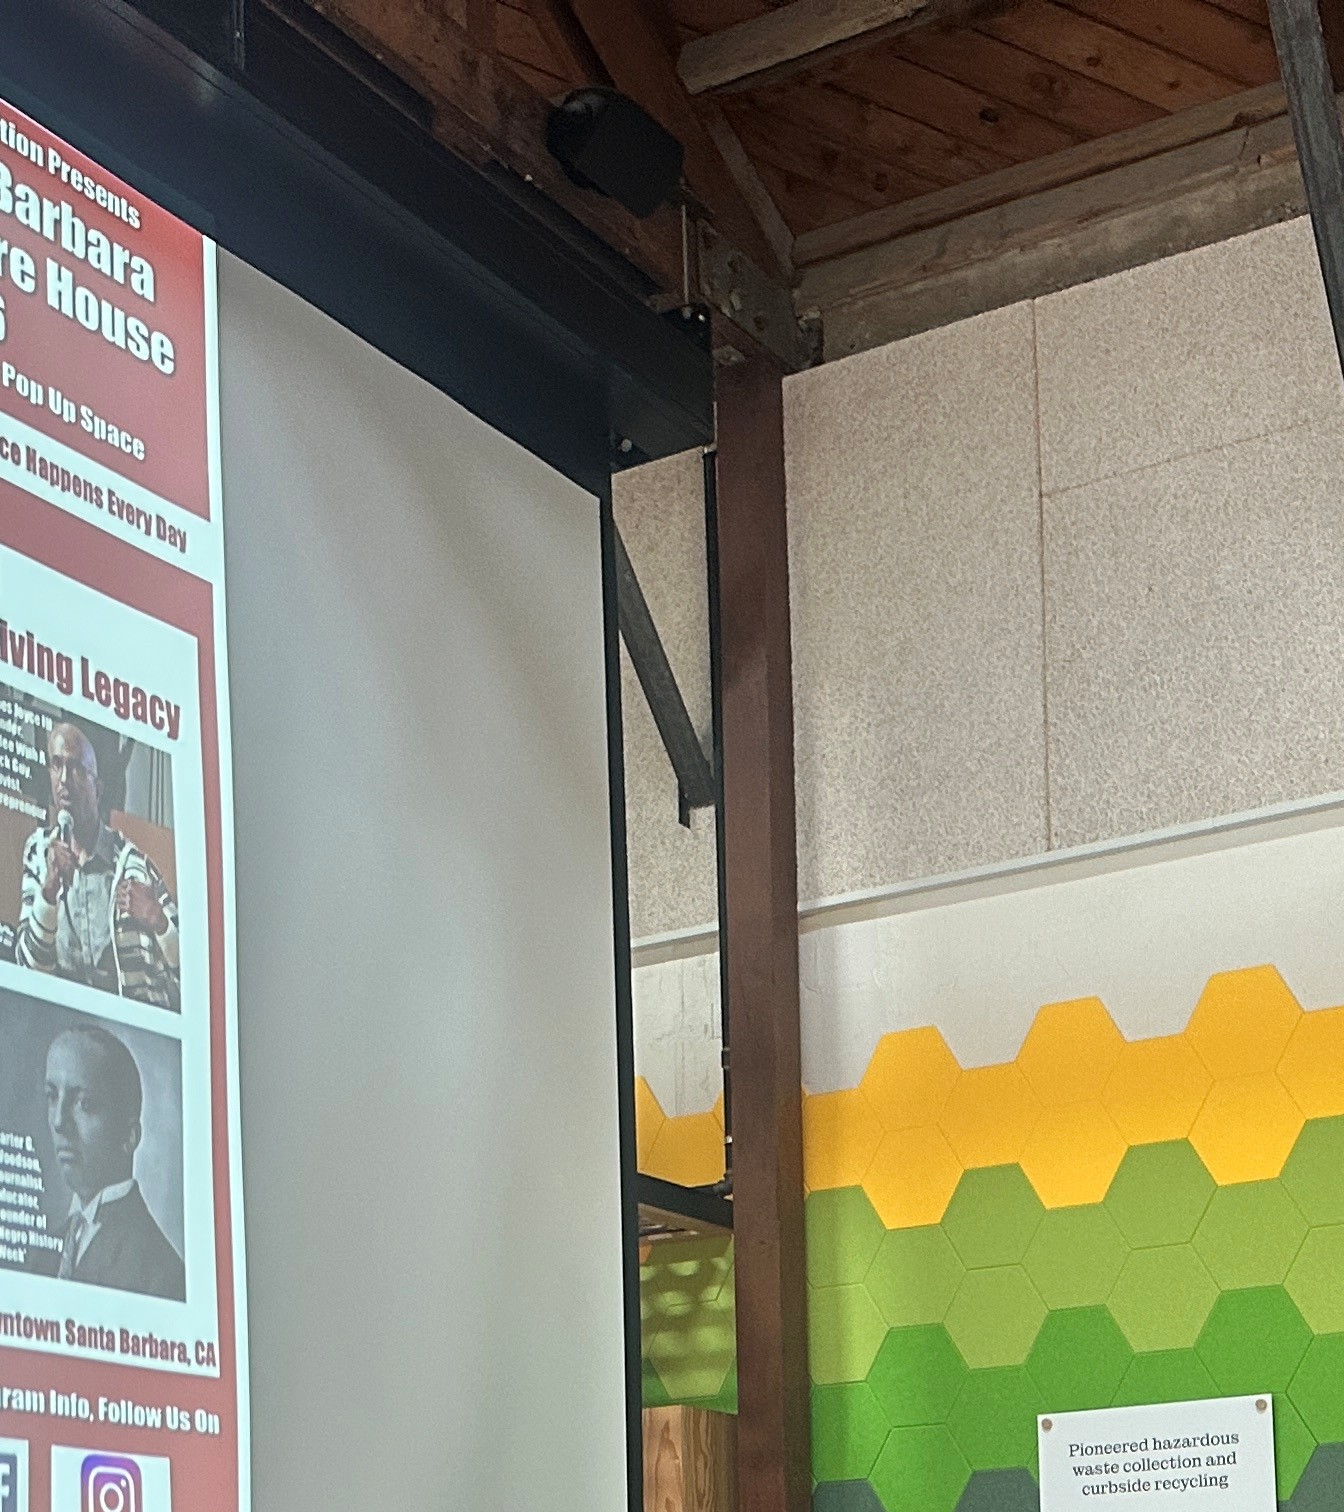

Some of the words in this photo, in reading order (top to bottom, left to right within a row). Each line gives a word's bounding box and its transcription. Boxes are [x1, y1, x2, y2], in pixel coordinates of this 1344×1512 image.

[47, 147, 141, 229] Presents
[46, 257, 176, 376] House
[2, 363, 44, 407] Pop
[48, 385, 77, 424] Up
[80, 406, 146, 461] Space
[25, 446, 104, 509] Happens
[107, 490, 152, 537] Every
[156, 512, 187, 554] Day
[80, 655, 182, 741] Legacy
[65, 1317, 116, 1355] Santa
[119, 1325, 191, 1368] Barbara,
[194, 1339, 217, 1368] CA
[49, 1389, 94, 1423] Info,
[97, 1395, 163, 1430] Follow
[166, 1405, 192, 1432] Us
[194, 1408, 220, 1436] On
[1069, 1438, 1149, 1458] Pioneered
[1152, 1432, 1240, 1451] hazardous
[1072, 1462, 1120, 1477] waste
[1123, 1455, 1202, 1473] collection
[1205, 1451, 1238, 1467] and
[1082, 1479, 1151, 1496] curbside
[1154, 1474, 1229, 1493] recycling
